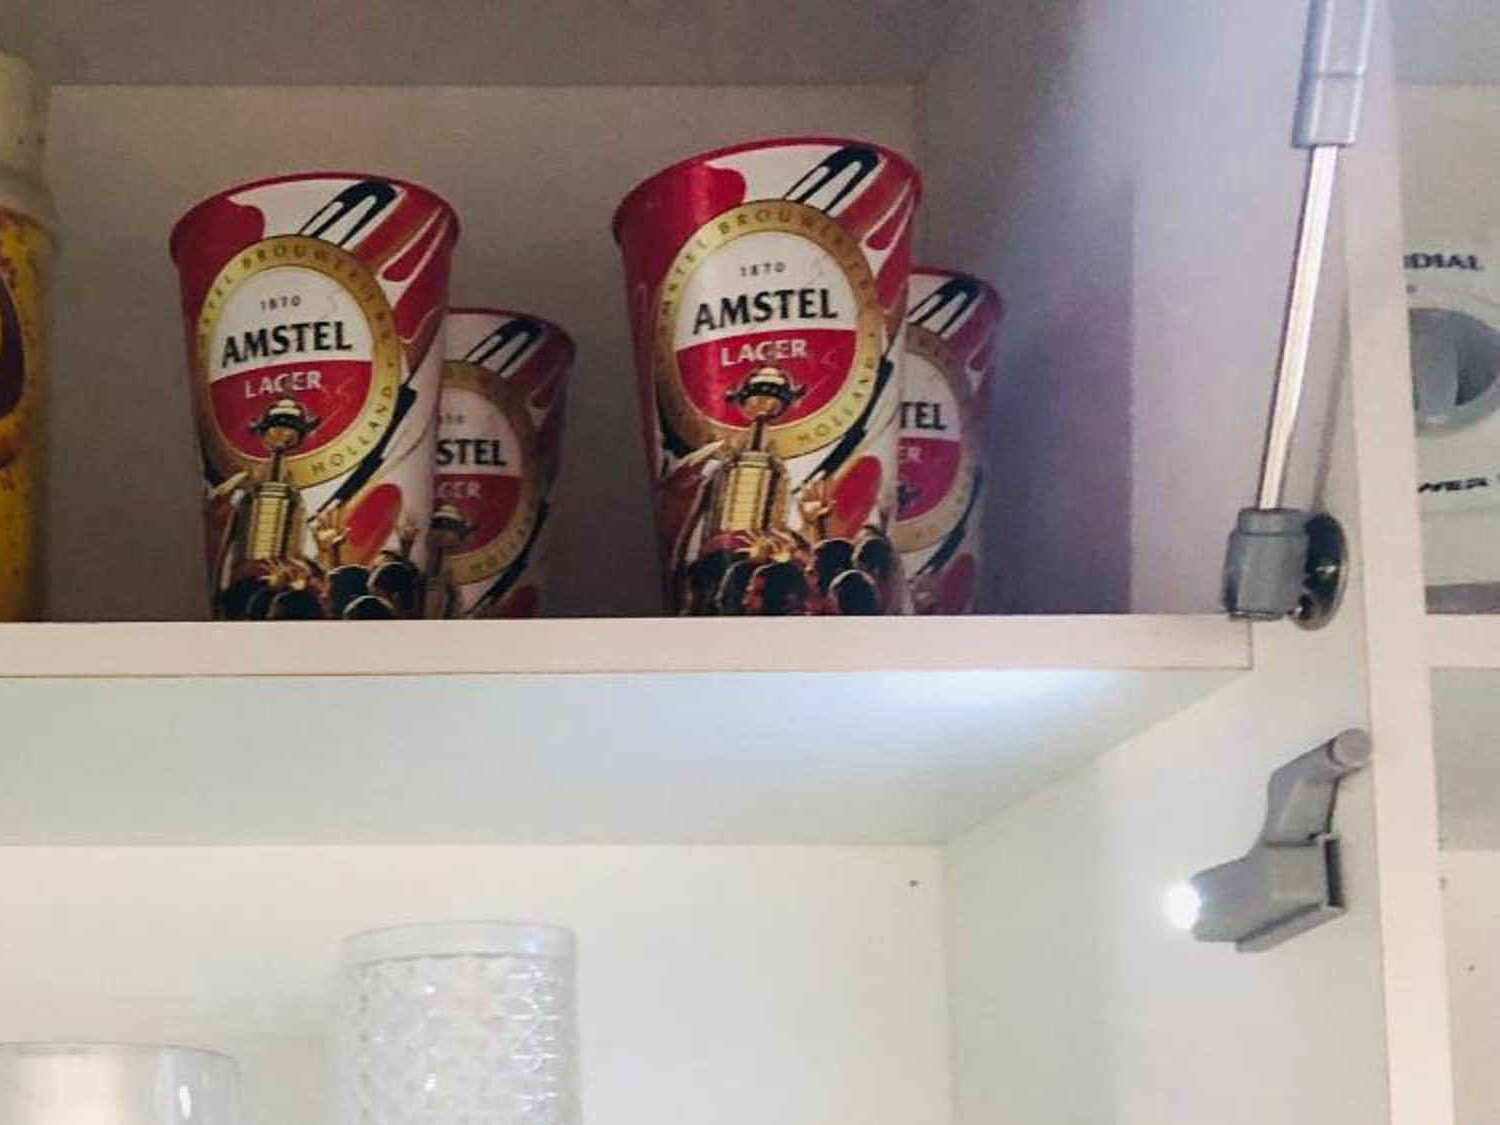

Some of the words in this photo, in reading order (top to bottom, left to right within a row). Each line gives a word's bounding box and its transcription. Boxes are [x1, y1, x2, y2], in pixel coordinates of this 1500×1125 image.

[693, 288, 839, 335] AMSTEL
[222, 320, 353, 368] AMSTEL
[721, 338, 808, 367] LAGER
[244, 370, 323, 399] LAGER
[900, 402, 948, 430] TEL
[436, 438, 507, 467] STEL
[438, 480, 483, 498] GER
